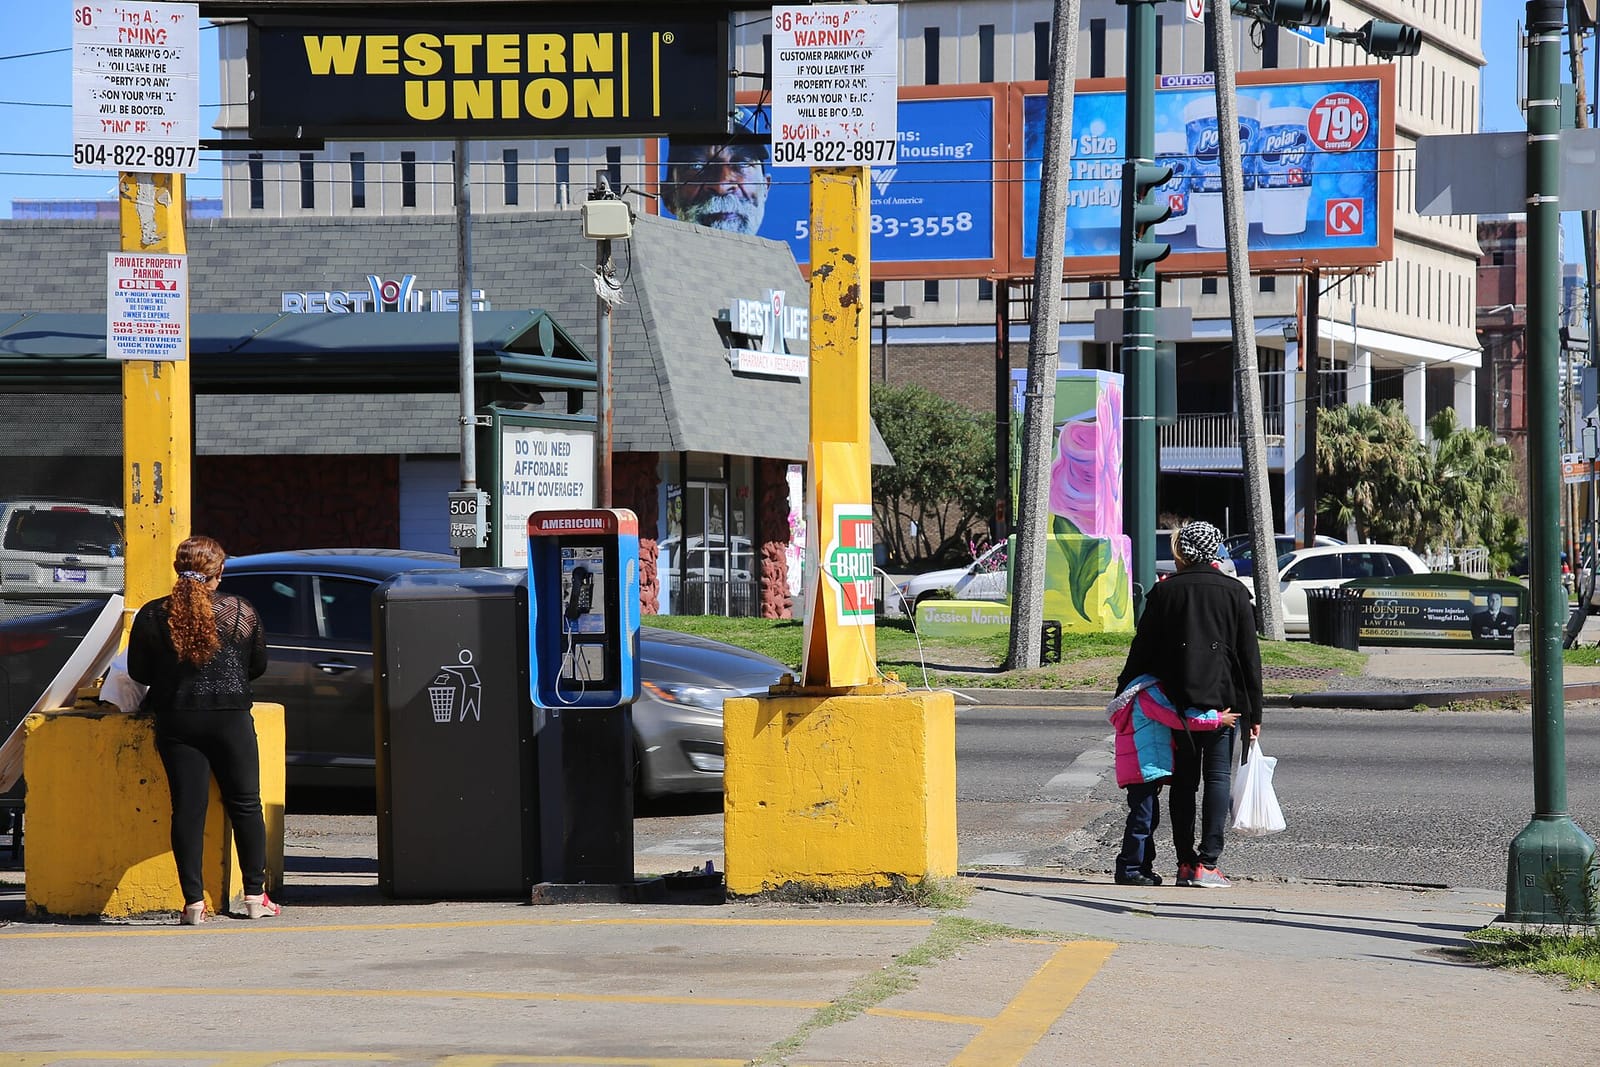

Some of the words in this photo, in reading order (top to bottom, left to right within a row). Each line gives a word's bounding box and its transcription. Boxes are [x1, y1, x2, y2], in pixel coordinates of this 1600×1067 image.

[75, 6, 92, 26] $6
[776, 12, 792, 31] $6
[303, 33, 614, 76] WESTERN
[780, 51, 822, 61] CUSTOMER
[797, 66, 804, 75] IF
[806, 65, 823, 75] YOU
[825, 65, 849, 75] LEAVE
[121, 91, 144, 101] YOUR
[404, 78, 615, 120] UNION
[820, 93, 843, 103] YOUR
[119, 105, 129, 114] BE
[798, 108, 816, 117] WILL
[818, 108, 828, 117] BE
[1080, 134, 1118, 155] Size
[1266, 130, 1298, 151] Polar
[1325, 141, 1352, 149] Everyday
[74, 144, 196, 167] 504-822-8977
[774, 140, 896, 162] 504-822-8977
[900, 143, 974, 158] housing?
[1280, 146, 1306, 165] Pop
[892, 197, 923, 205] America
[114, 257, 143, 268] PRIVATE
[145, 258, 182, 269] PROPERTY
[133, 269, 164, 279] PARKING
[121, 280, 174, 290] ONLY
[281, 291, 371, 313] BEST
[738, 299, 771, 337] BEST
[784, 305, 808, 340] LIFE
[515, 440, 529, 455] DO
[532, 441, 548, 456] YOU
[551, 442, 571, 456] NEED
[514, 461, 568, 476] AFFORDABLE
[537, 481, 584, 497] COVERAGE?
[450, 500, 477, 515] 506
[541, 518, 603, 529] AMERICOIN
[925, 607, 968, 623] Jessica
[1444, 608, 1465, 616] Injuries
